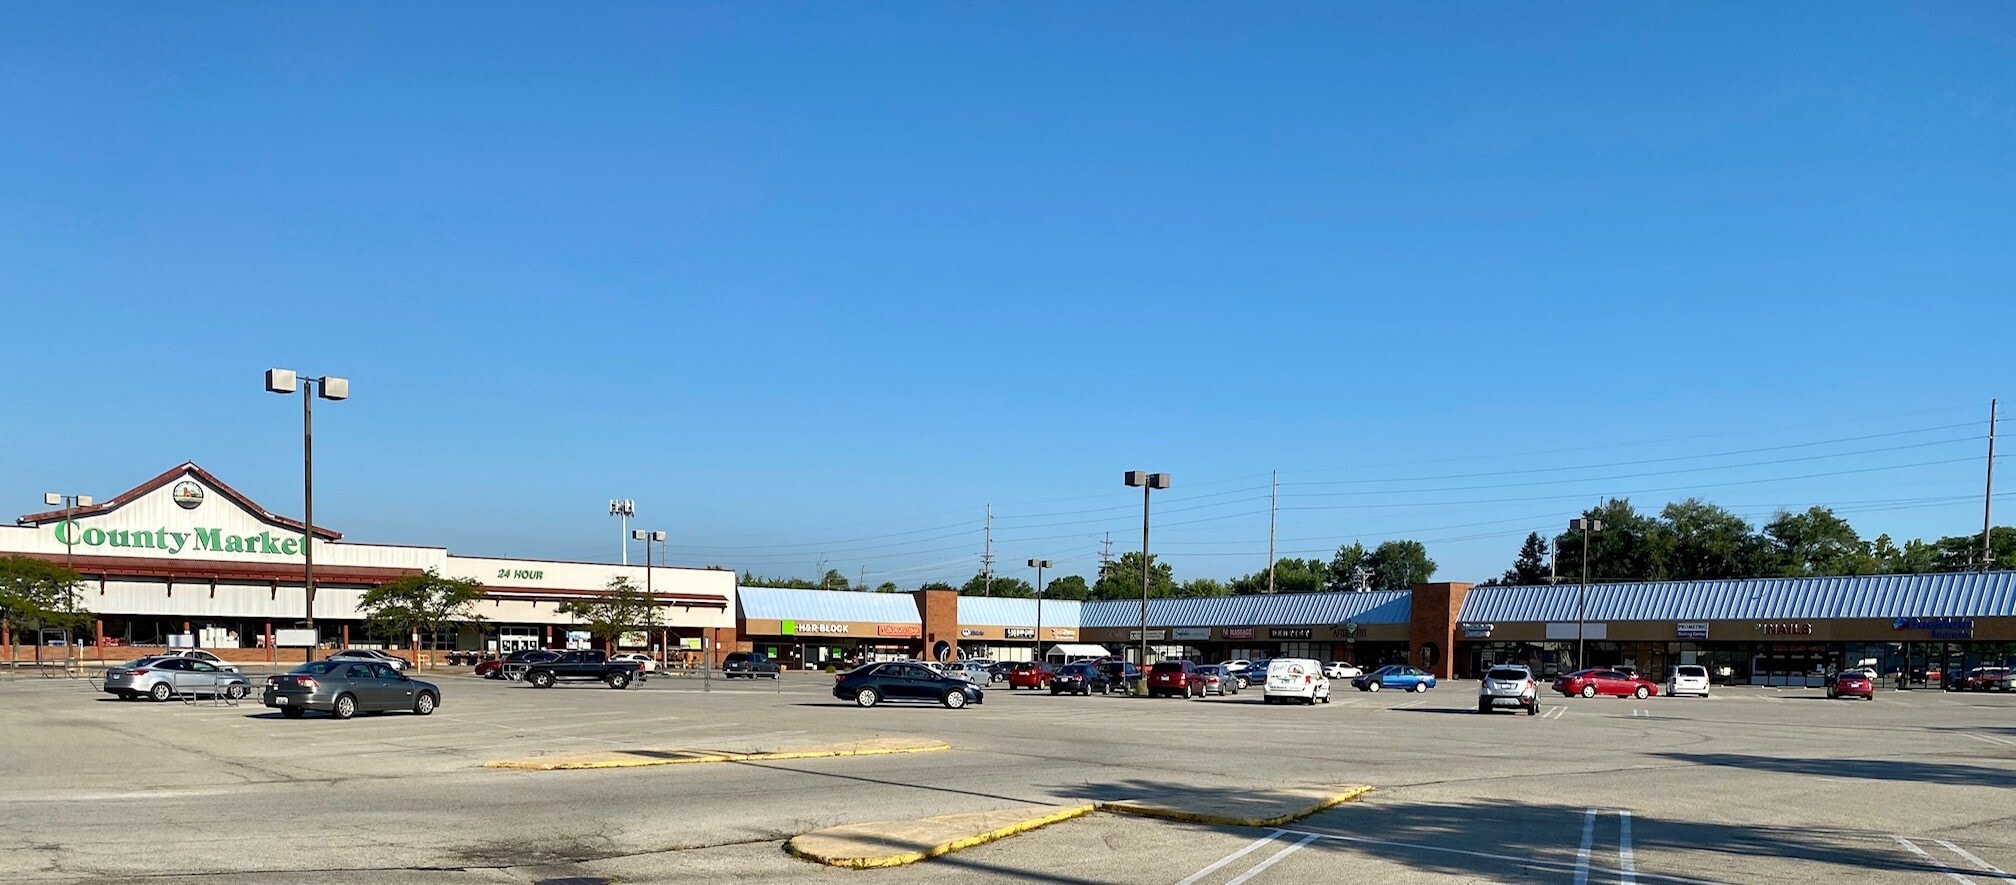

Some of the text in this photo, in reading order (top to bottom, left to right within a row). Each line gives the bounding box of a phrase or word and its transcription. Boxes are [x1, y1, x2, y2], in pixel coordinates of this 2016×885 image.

[54, 519, 306, 555] County Market
[497, 568, 544, 580] 24 HOUR
[798, 623, 849, 633] H&R BLOCK
[1229, 628, 1253, 636] MASSAGE
[1271, 629, 1310, 638] DENTIST
[1766, 623, 1812, 635] NAILS
